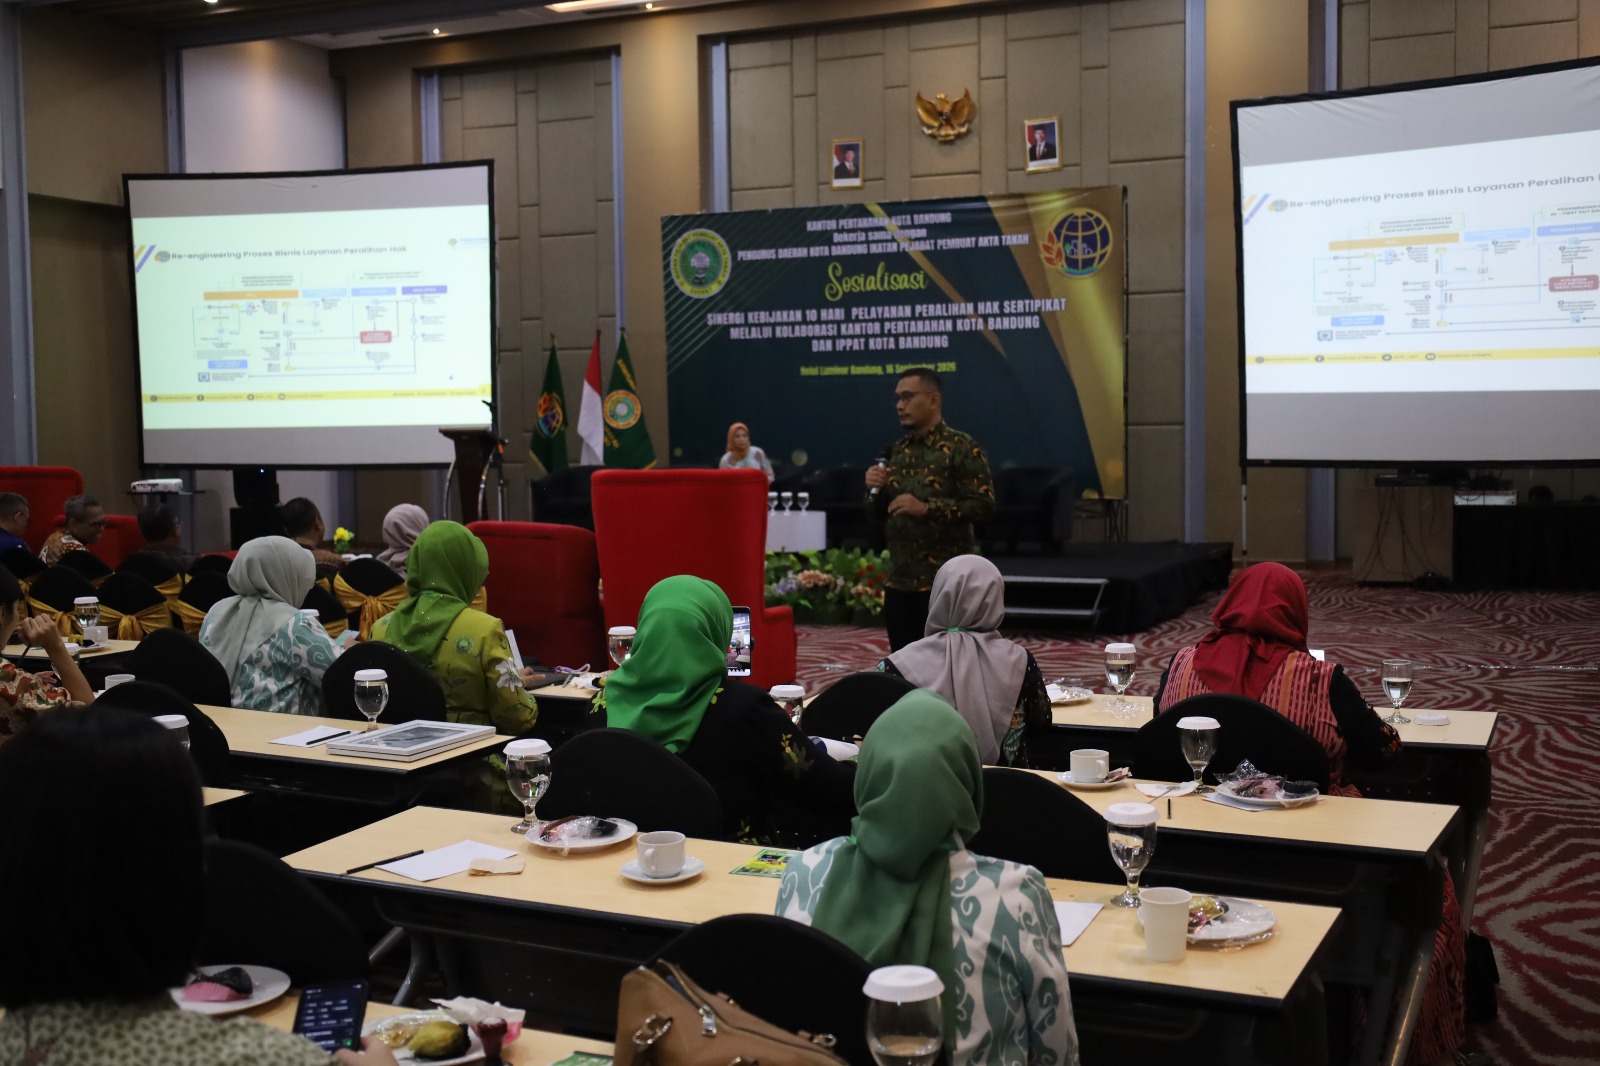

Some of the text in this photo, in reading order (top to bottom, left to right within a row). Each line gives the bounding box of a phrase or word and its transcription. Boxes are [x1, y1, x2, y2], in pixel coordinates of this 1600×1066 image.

[1290, 175, 1594, 207] Re-engineering Proses Bisnis Layanan Peralihan
[807, 212, 952, 231] KANTOR PERTANAHAN KOTA BANDUNG
[737, 233, 1029, 261] PENGURUS DAERAH KOTA BANDUNG IKATAN PEJABAT PEMBUAT AKTA TANAH
[834, 228, 927, 243] Bekerja sama dengan
[171, 251, 241, 260] Re-engineering
[244, 250, 272, 258] Proses
[303, 248, 341, 257] Layanan
[344, 246, 387, 254] Peralihan
[825, 261, 927, 301] Sosialisasi
[707, 298, 1067, 325] SINERGI KEBIJAKAN 10 HARI PELAYANAN PERALIHAN HAK SERTIPIKAT
[730, 316, 1040, 340] MELALUI KOLABORASI KANTOR PERTANAHAN KOTA BANDUNG
[812, 335, 949, 352] DAN IPPAT KOTA BANDUNG
